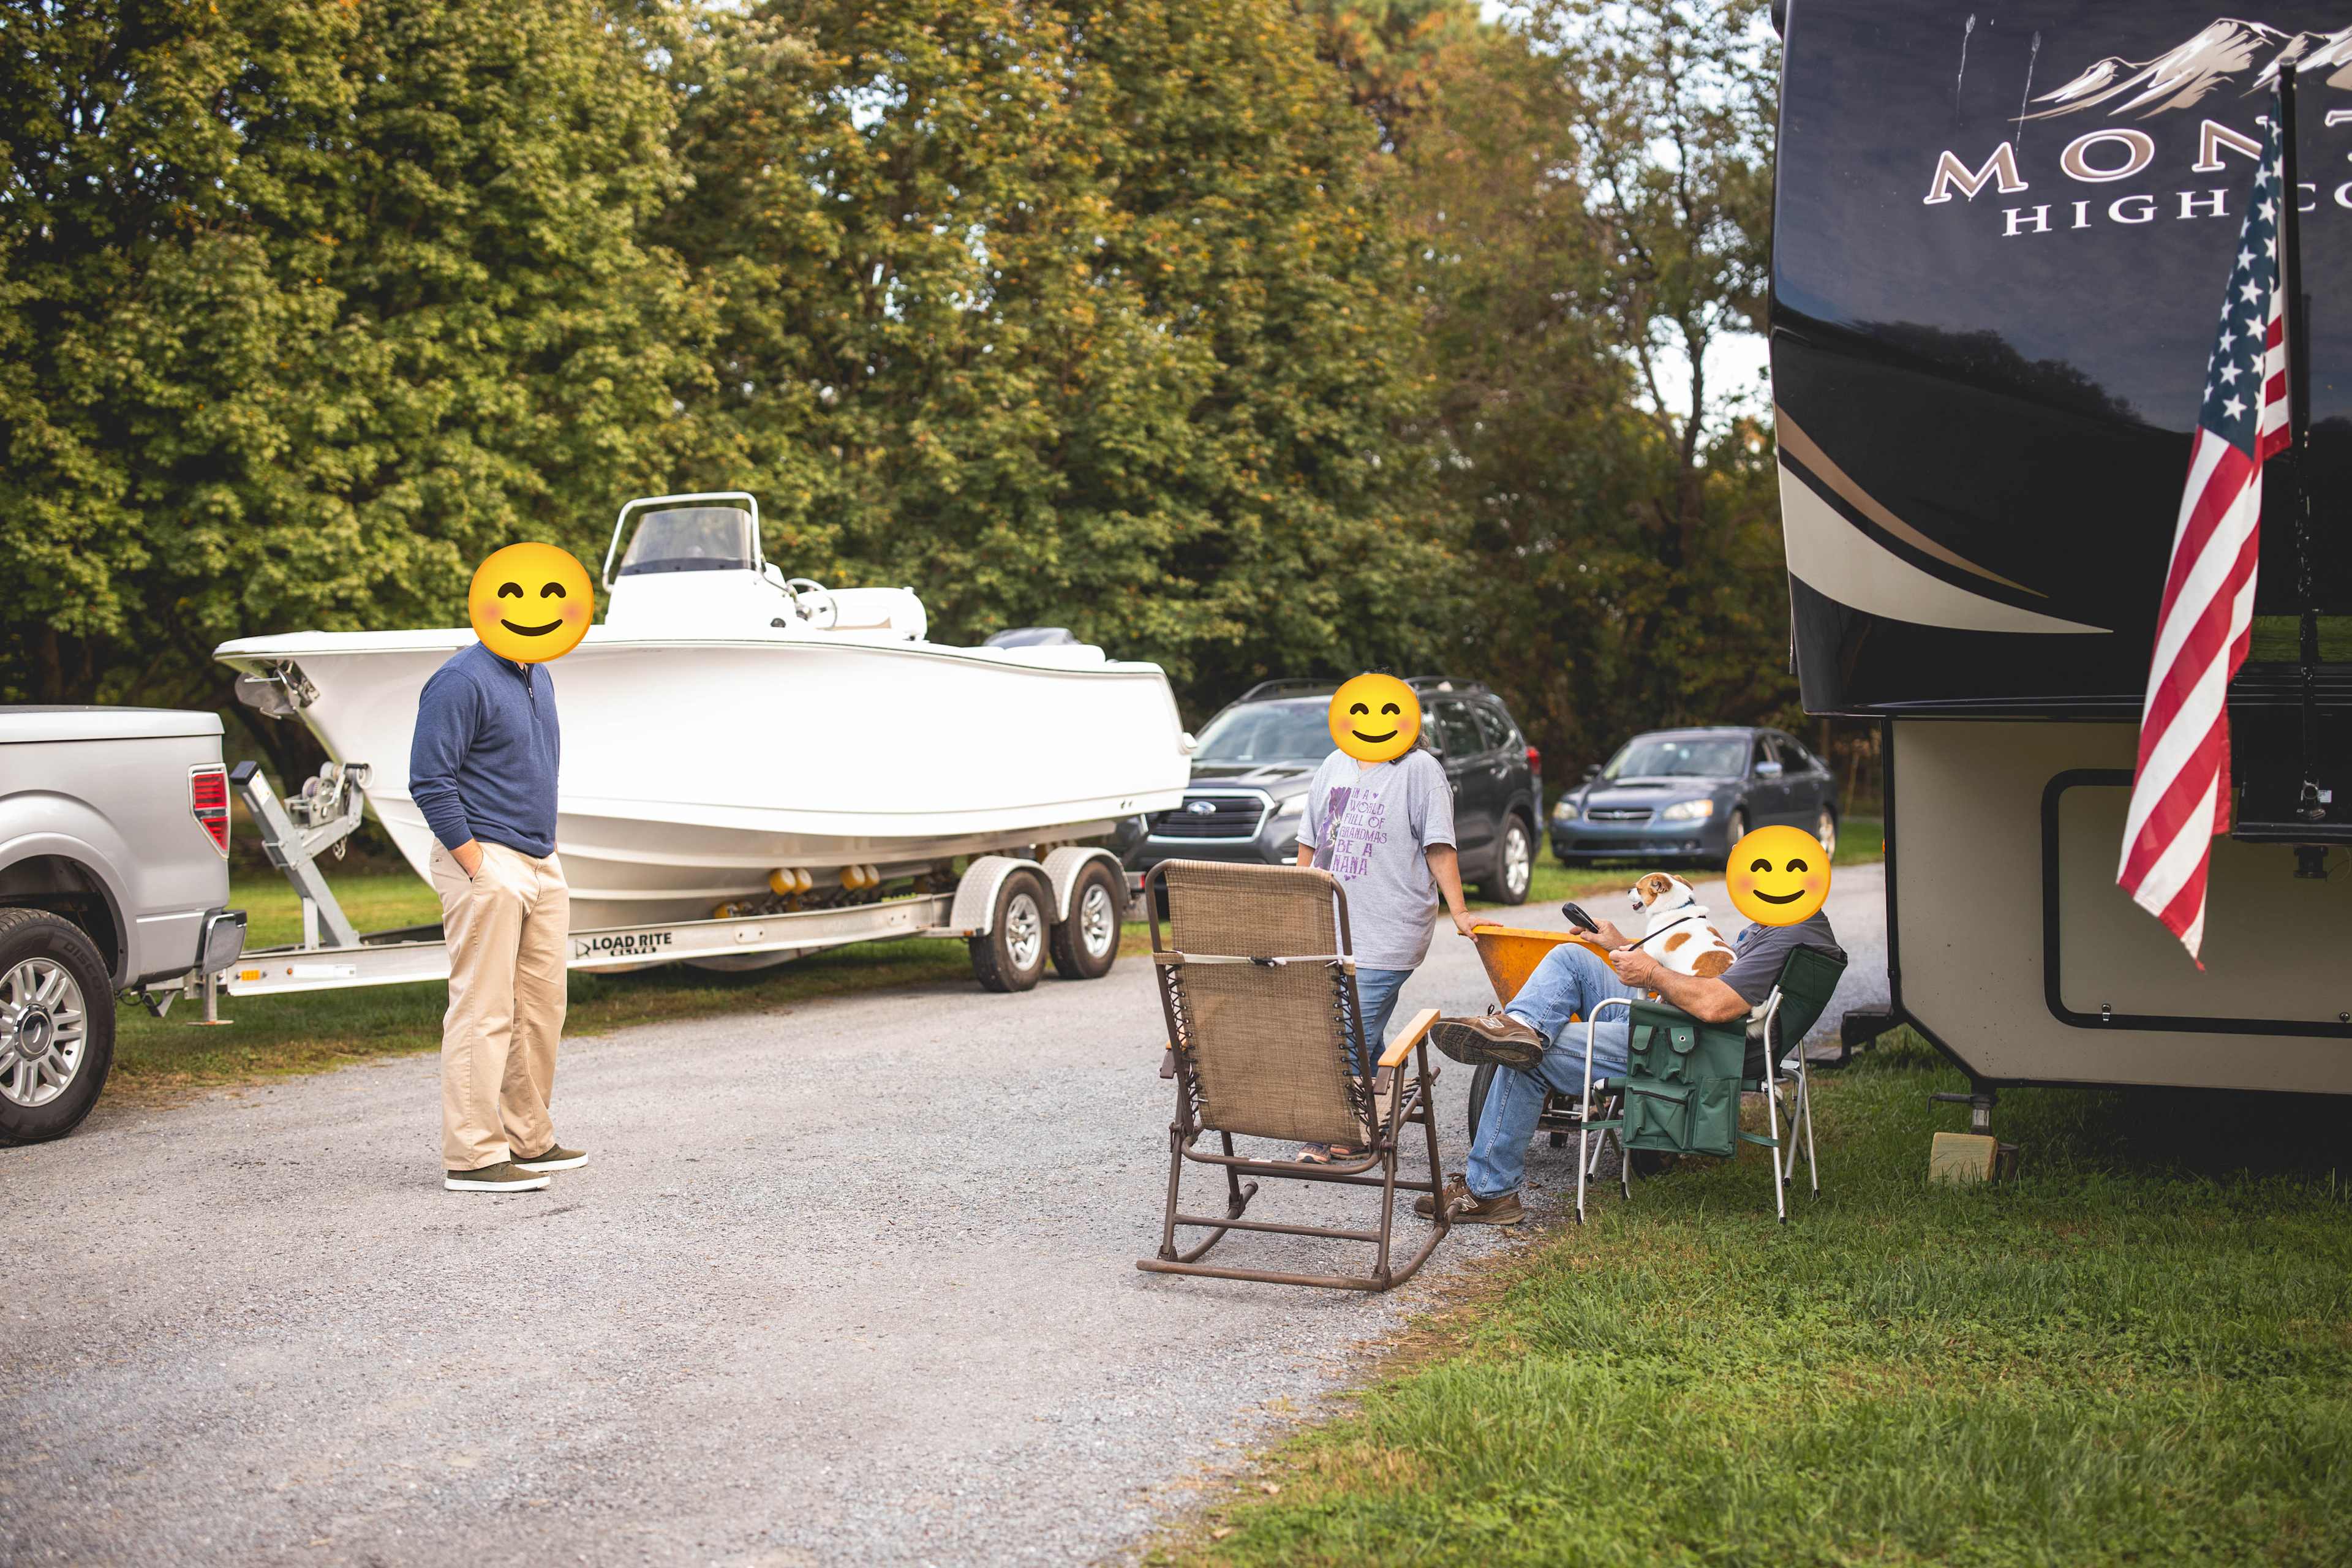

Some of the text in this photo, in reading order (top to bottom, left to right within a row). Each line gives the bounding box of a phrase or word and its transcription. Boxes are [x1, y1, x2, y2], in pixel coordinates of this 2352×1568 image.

[2002, 188, 2231, 238] HIGH
[1351, 787, 1370, 799] IN A
[1350, 800, 1384, 815] WORLD
[1343, 813, 1385, 829] FULL OF
[1340, 826, 1387, 843] GRANDMAS
[1336, 839, 1373, 858] BE A
[1332, 854, 1368, 876] NANA
[592, 932, 672, 950] LOAD RITE
